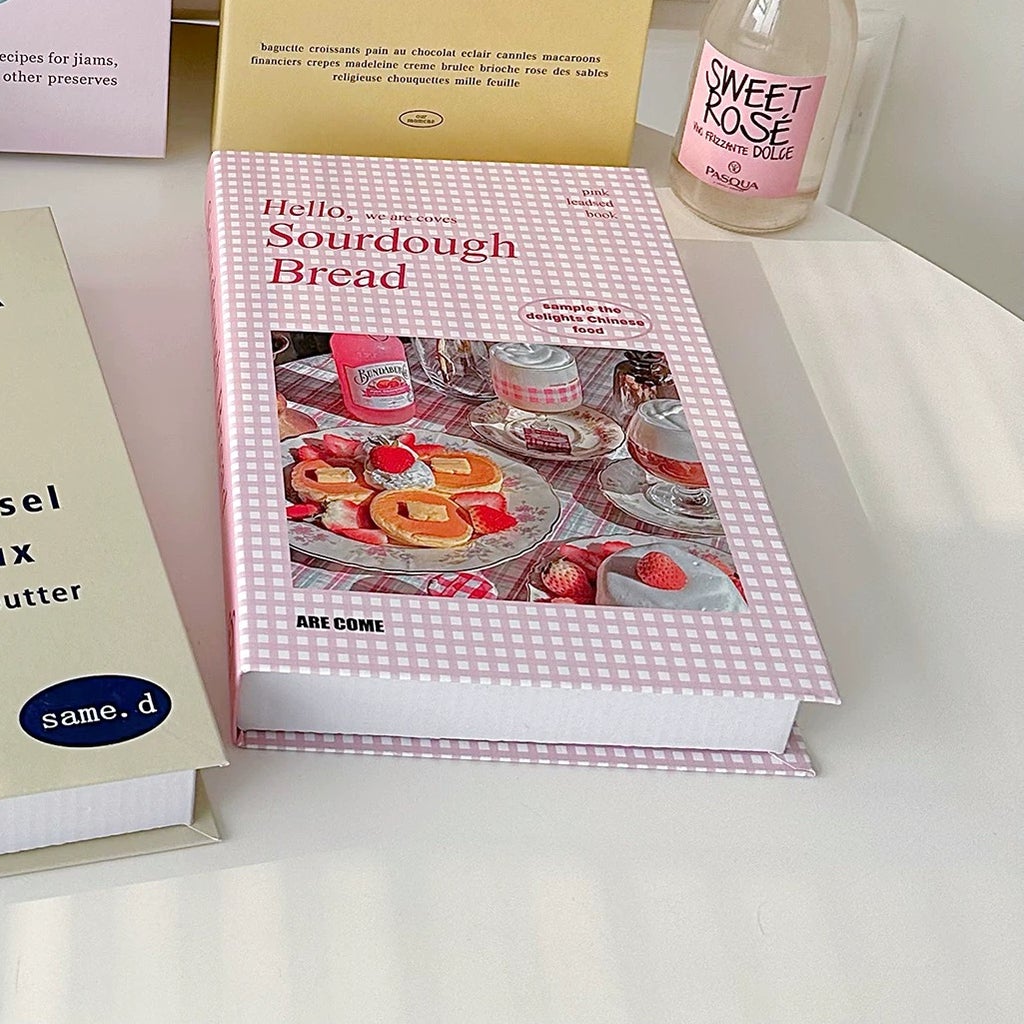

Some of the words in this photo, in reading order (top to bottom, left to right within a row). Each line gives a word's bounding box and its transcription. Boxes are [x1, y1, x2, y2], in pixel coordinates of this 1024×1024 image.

[47, 51, 69, 66] for
[72, 53, 119, 68] jiams,
[261, 43, 304, 53] baguette
[309, 45, 361, 54] croissants
[365, 46, 389, 56] pain
[394, 48, 406, 56] au
[411, 48, 456, 58] chocolat
[461, 49, 491, 58] eclair
[542, 54, 601, 63] macaroons
[251, 56, 302, 66] financiers
[306, 59, 341, 68] crepes
[345, 59, 399, 69] madeleine
[403, 62, 436, 71] creme
[441, 62, 475, 72] brulee
[480, 64, 521, 74] brioche
[525, 67, 548, 75] rose
[553, 67, 570, 76] des
[575, 69, 609, 78] sables
[2, 70, 43, 84] other
[47, 74, 118, 87] preserves
[332, 73, 382, 83] religieuse
[387, 74, 450, 85] chouquettes
[455, 77, 482, 86] mille
[486, 77, 521, 87] feuille
[706, 58, 812, 114] SWEET
[703, 87, 793, 146] ROSÉ
[753, 145, 795, 161] DOLCE
[705, 165, 759, 191] PASQUA
[582, 188, 610, 197] pink
[262, 199, 353, 223] Hello,
[365, 212, 386, 221] we
[416, 216, 458, 225] coves
[585, 210, 618, 219] book
[266, 222, 518, 264] Sourdough
[268, 258, 408, 291] Bread
[543, 303, 595, 314] sample
[598, 305, 621, 314] the
[526, 312, 583, 323] delights
[587, 315, 645, 327] Chinese
[572, 325, 605, 335] food
[296, 615, 330, 629] ARE
[333, 617, 385, 633] COME
